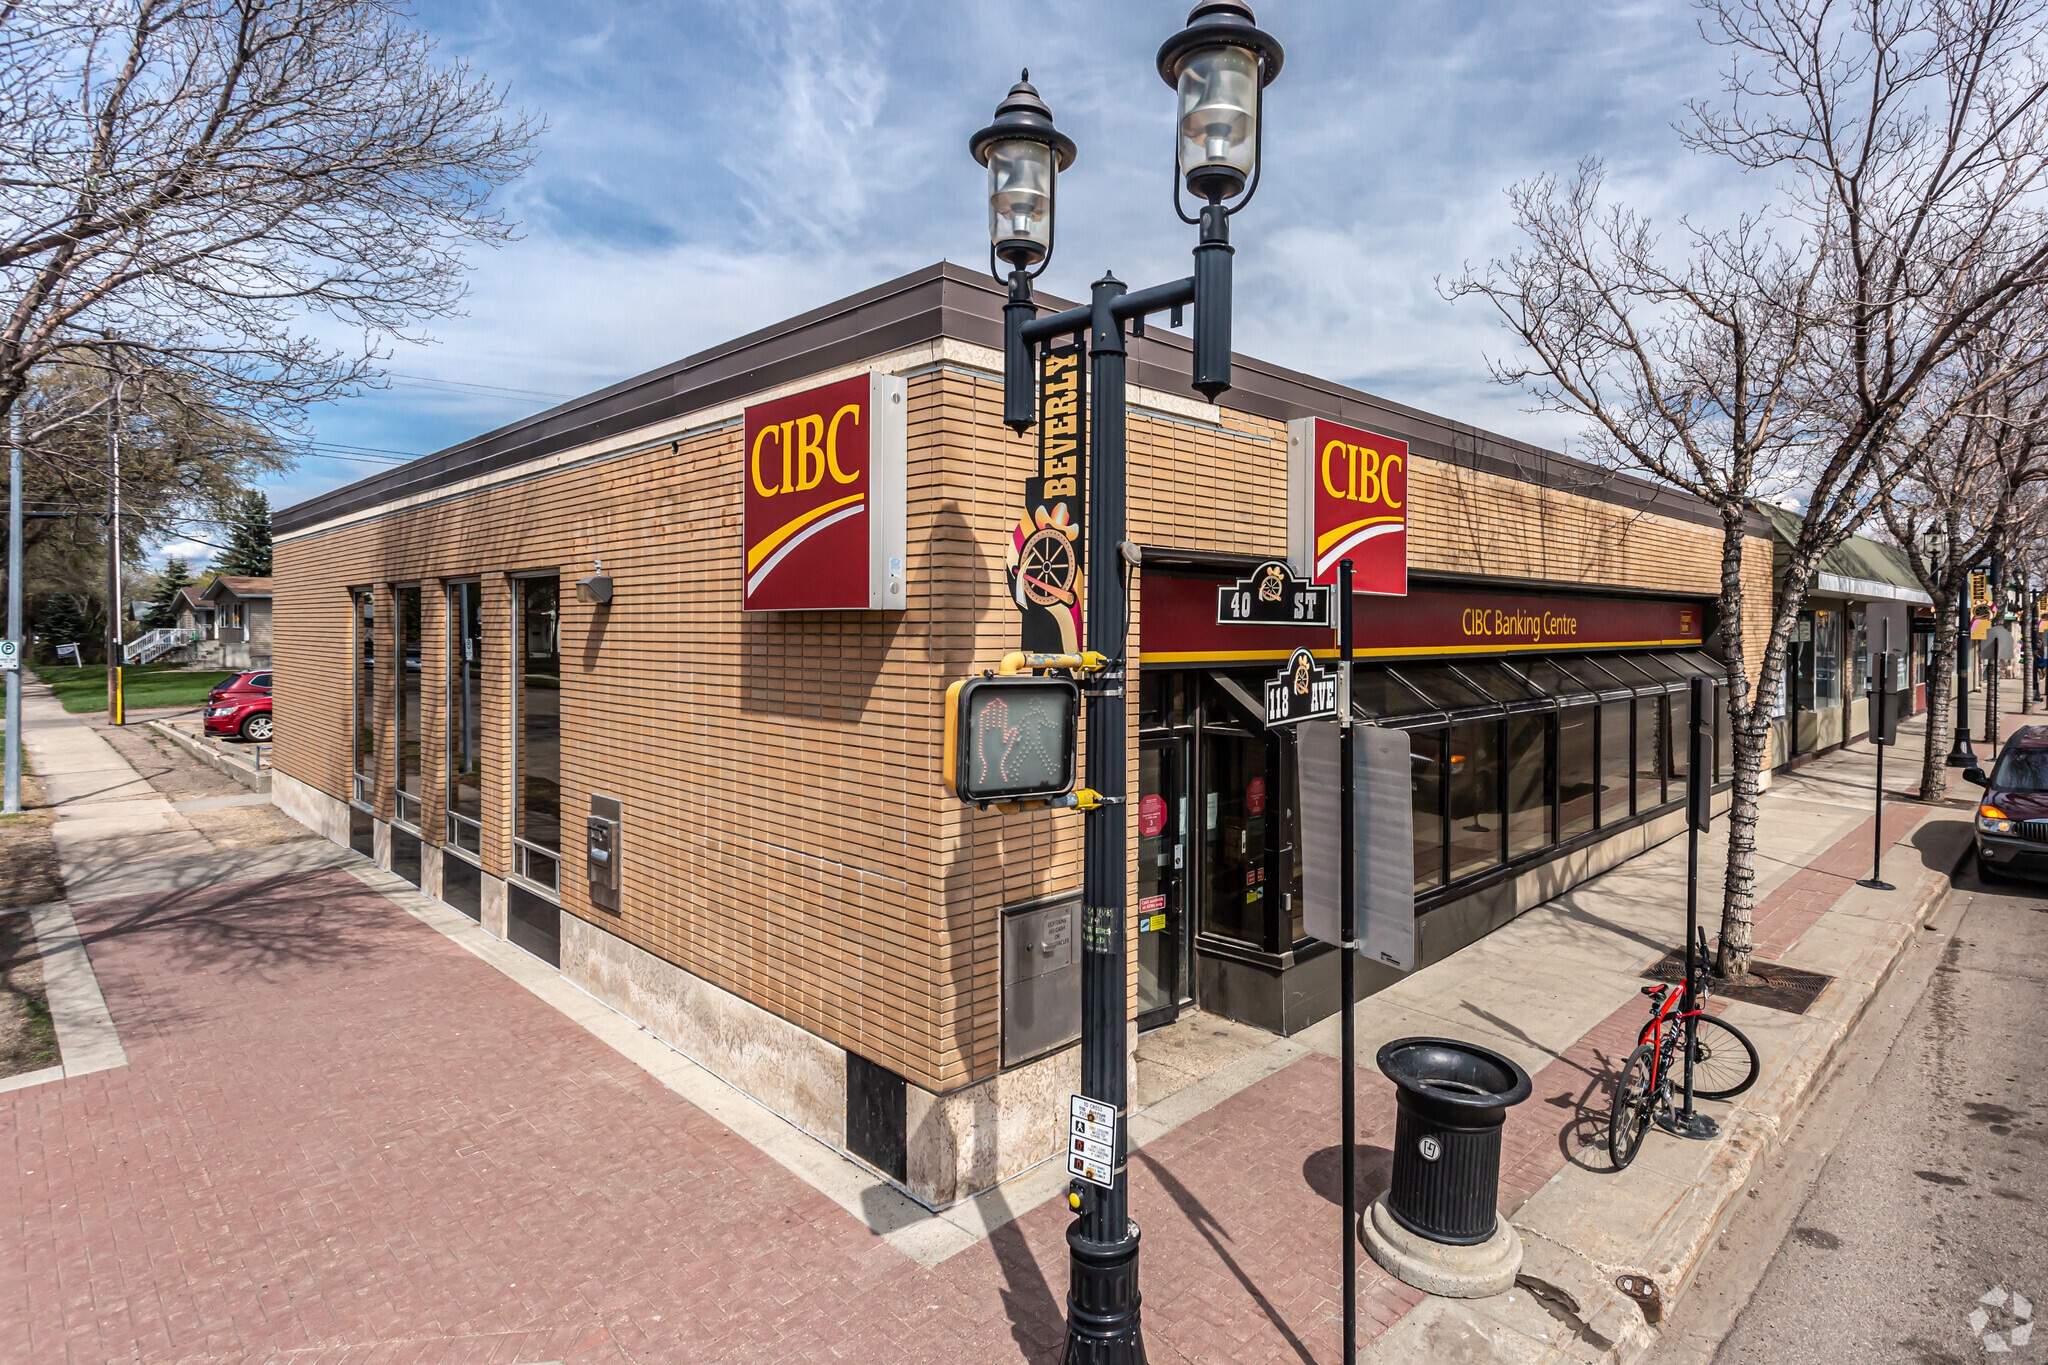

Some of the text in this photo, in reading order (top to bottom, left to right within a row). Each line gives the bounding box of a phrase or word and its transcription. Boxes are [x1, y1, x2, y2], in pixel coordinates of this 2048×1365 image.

[1043, 353, 1078, 500] BEVERLY
[751, 403, 860, 498] CIBC
[1321, 439, 1403, 509] CIBC
[1230, 591, 1317, 619] 40 ST
[1462, 608, 1577, 642] CIBC Banking Centre
[1269, 680, 1334, 720] 118 AVE
[1047, 918, 1067, 928] CONTAINS
